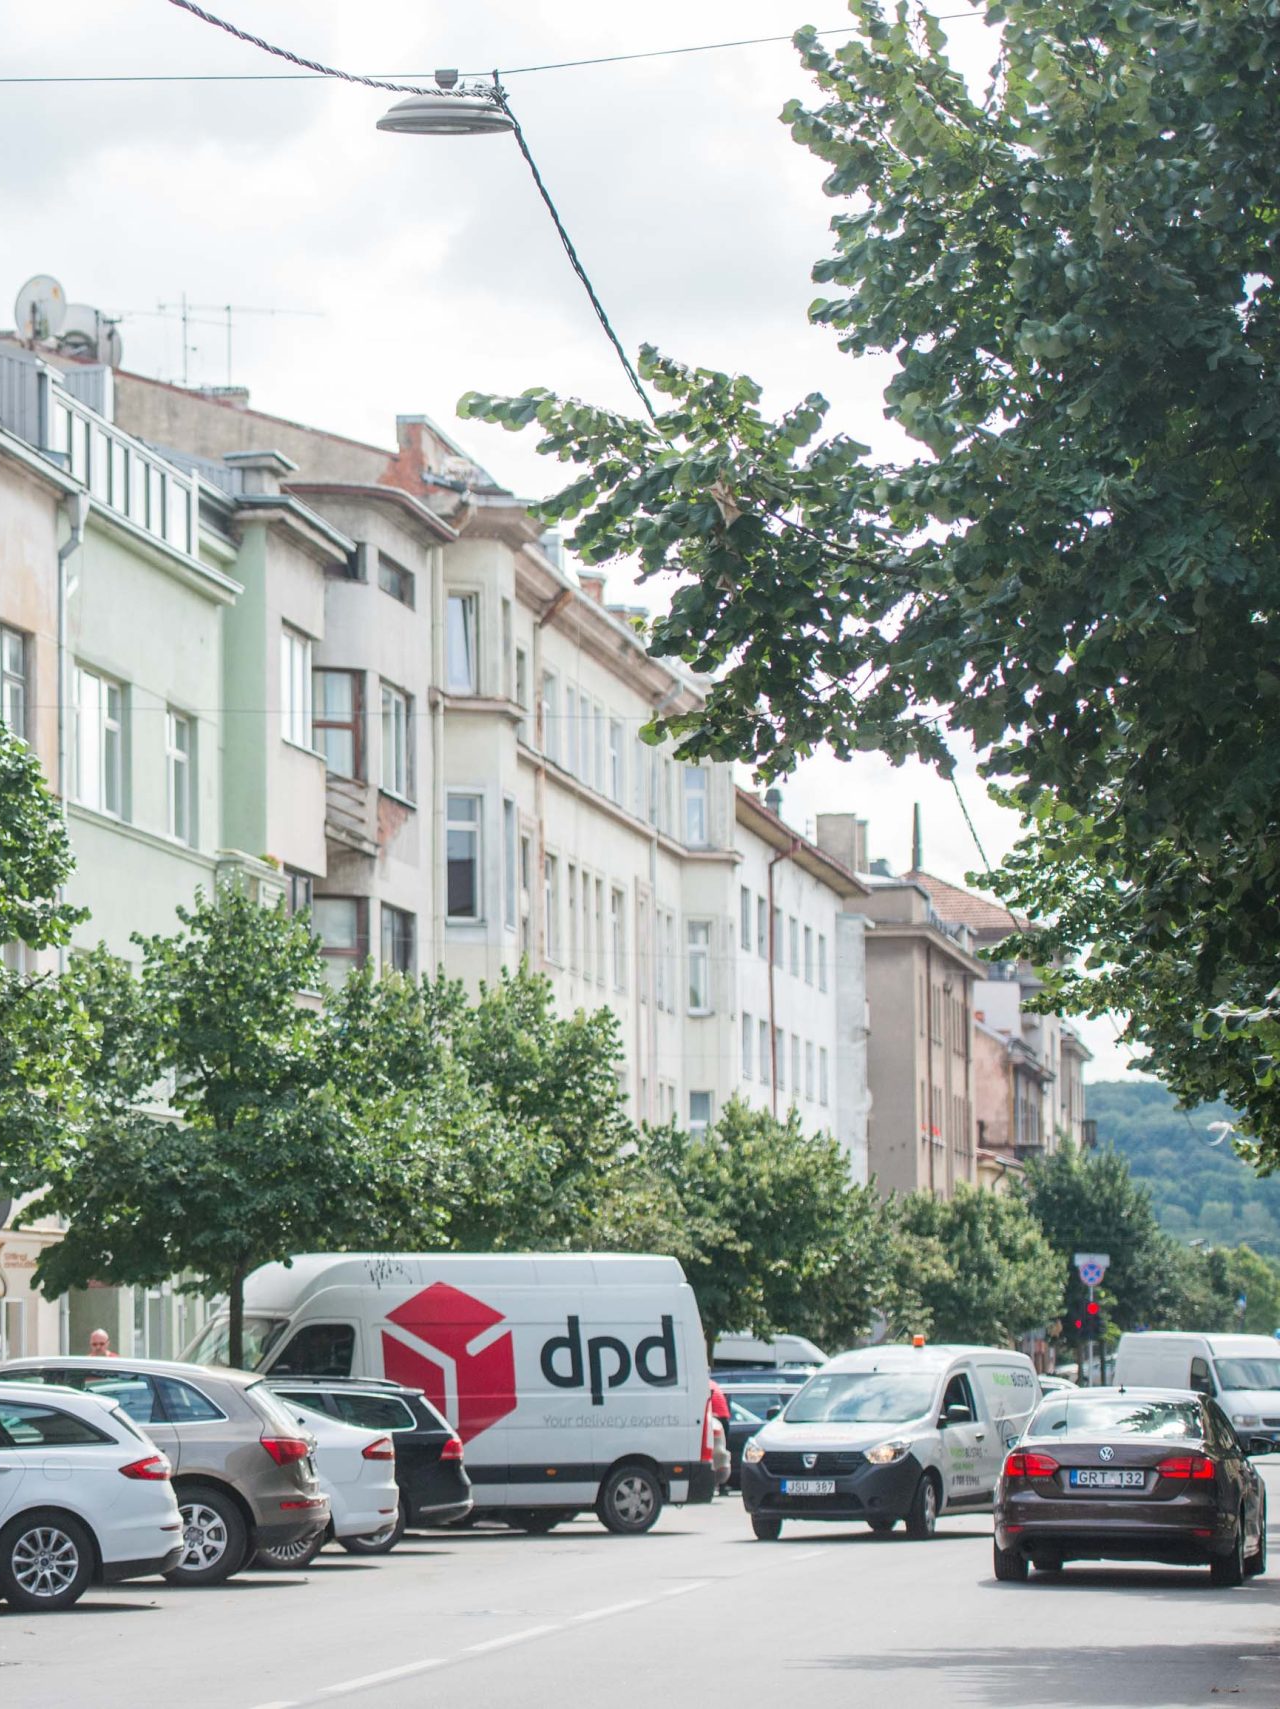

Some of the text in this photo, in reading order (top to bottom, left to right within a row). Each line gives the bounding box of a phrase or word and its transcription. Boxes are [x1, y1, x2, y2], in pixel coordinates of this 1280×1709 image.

[540, 1314, 679, 1406] dpd
[543, 1413, 680, 1429] Your delivery experts
[1079, 1471, 1142, 1484] GRT 132
